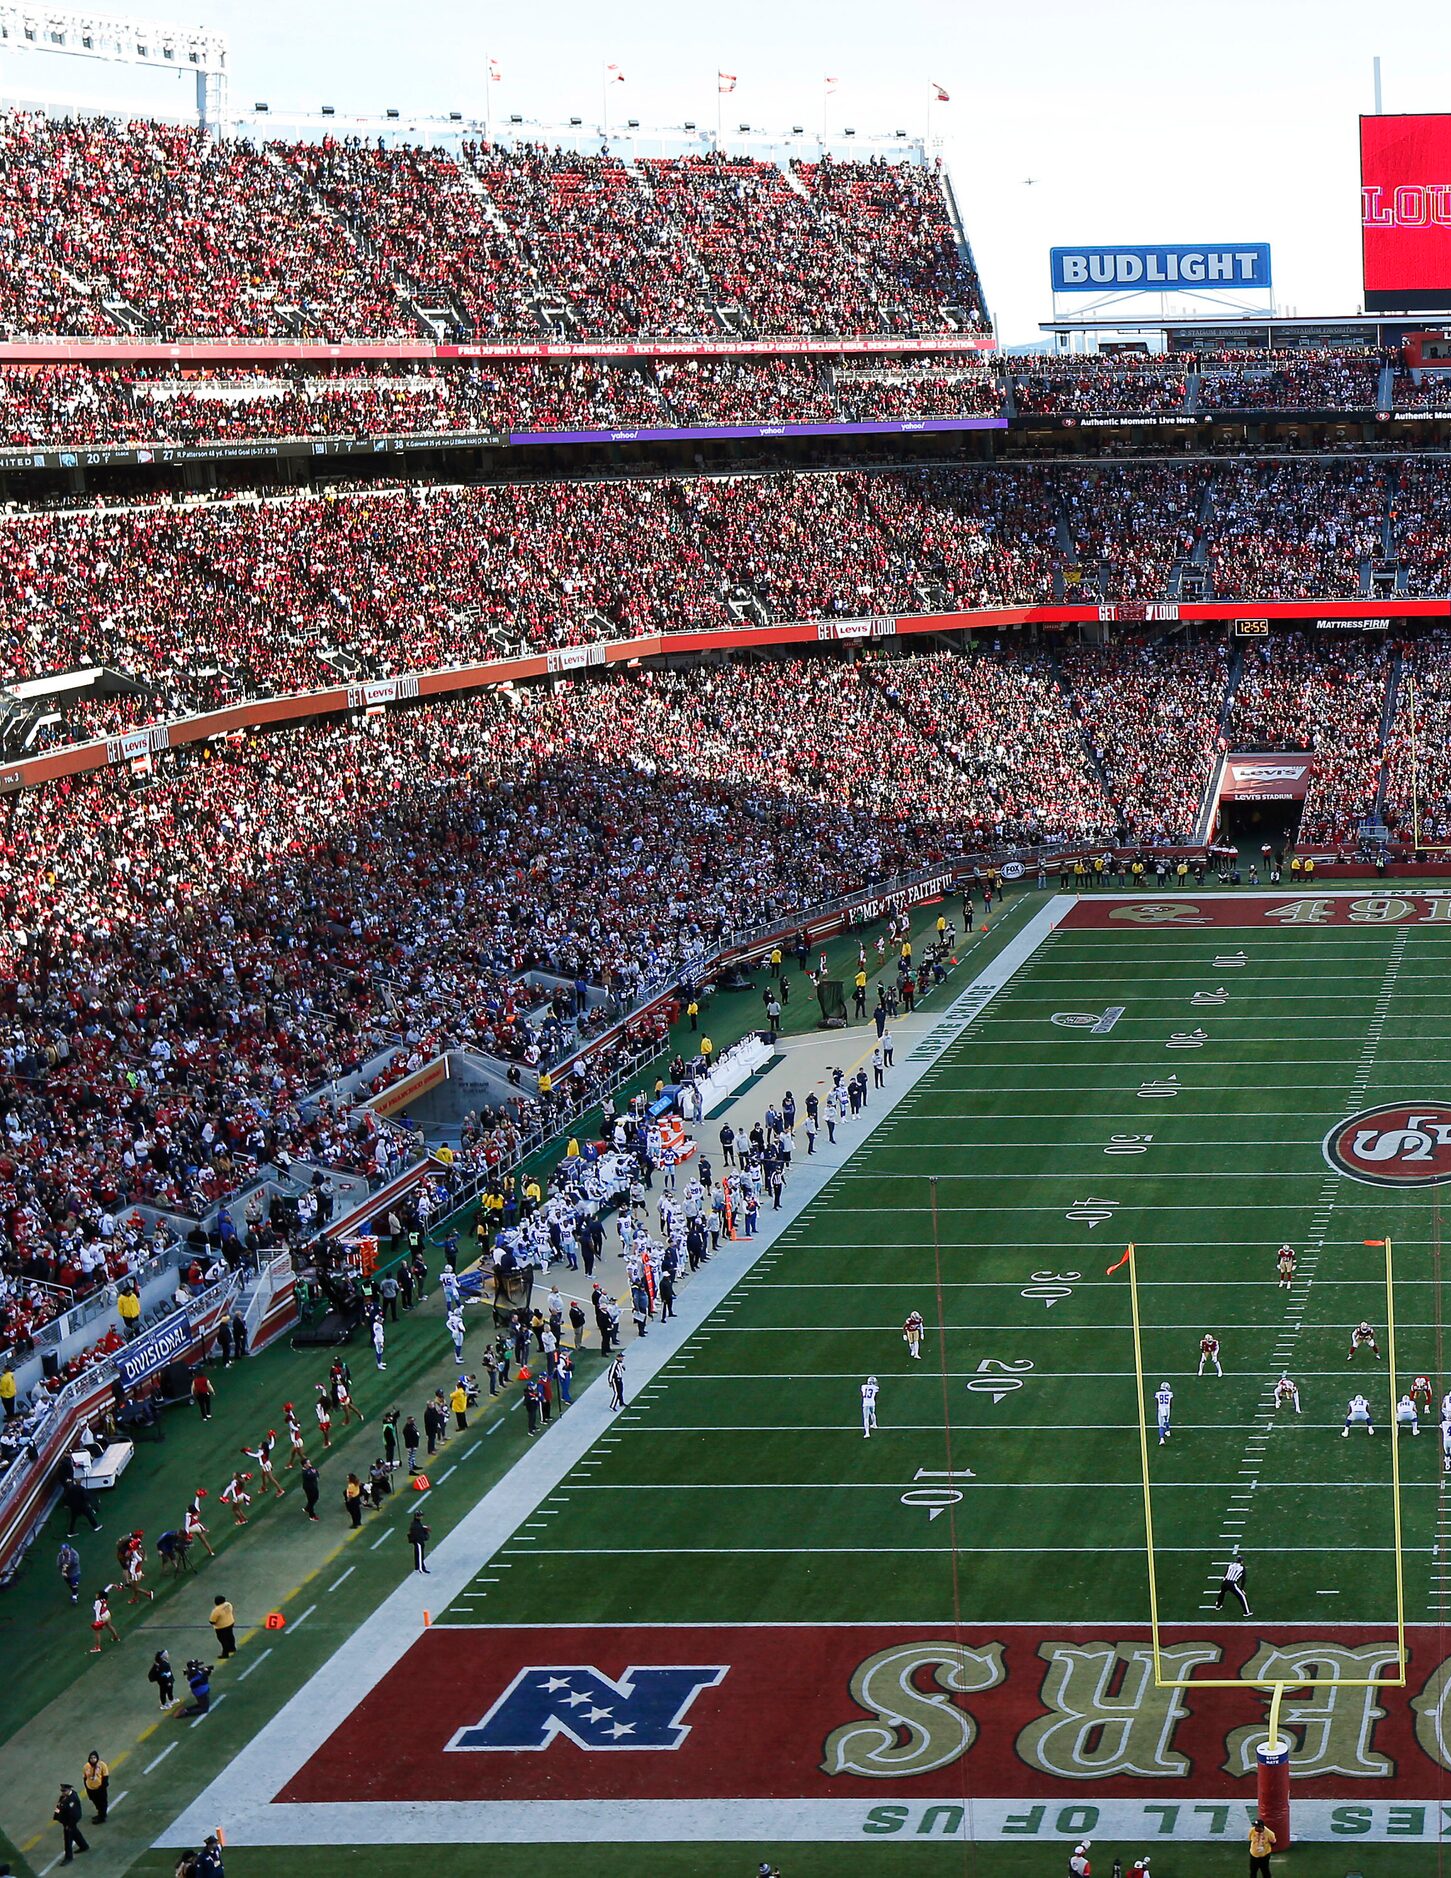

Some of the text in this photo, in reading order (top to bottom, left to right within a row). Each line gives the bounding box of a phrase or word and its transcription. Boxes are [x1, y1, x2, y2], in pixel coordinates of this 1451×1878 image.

[1063, 252, 1258, 283] BUD LIGHT
[458, 347, 481, 355] FREE
[482, 346, 517, 355] XFINITY
[547, 345, 571, 354] NEED
[572, 345, 628, 354] ASSISTANCE?
[633, 345, 655, 353] TEXT
[1080, 418, 1119, 426] Authentic
[1120, 417, 1157, 425] Moments
[1176, 416, 1198, 424] Here.
[1394, 412, 1433, 420] Authentic
[611, 431, 638, 440] yahoo!
[760, 426, 786, 436] yahoo!
[902, 422, 926, 432] yahoo!
[394, 440, 404, 450] 38
[87, 453, 100, 464] 20
[163, 450, 174, 461] 27
[1099, 606, 1115, 621] GET
[1154, 605, 1179, 620] LOUD
[818, 624, 835, 640] GET
[873, 619, 896, 636] LOUD
[1239, 621, 1267, 633] 12:55
[547, 656, 560, 673] GET
[588, 648, 606, 666] LOUD
[398, 678, 420, 698] LOUD
[347, 688, 364, 708] GET
[150, 727, 169, 751] LOUD
[107, 741, 122, 763] GET
[1005, 865, 1019, 875] FOX
[905, 985, 997, 1062] INSPIRE CHANGE
[1103, 1133, 1154, 1156] 50
[1020, 1271, 1082, 1298] 30
[125, 1327, 187, 1379] DIVISIONAL
[966, 1359, 1035, 1392] 20
[900, 1467, 976, 1506] 10
[862, 1805, 965, 1834] US
[1001, 1805, 1099, 1834] OF
[1144, 1805, 1258, 1834] LL
